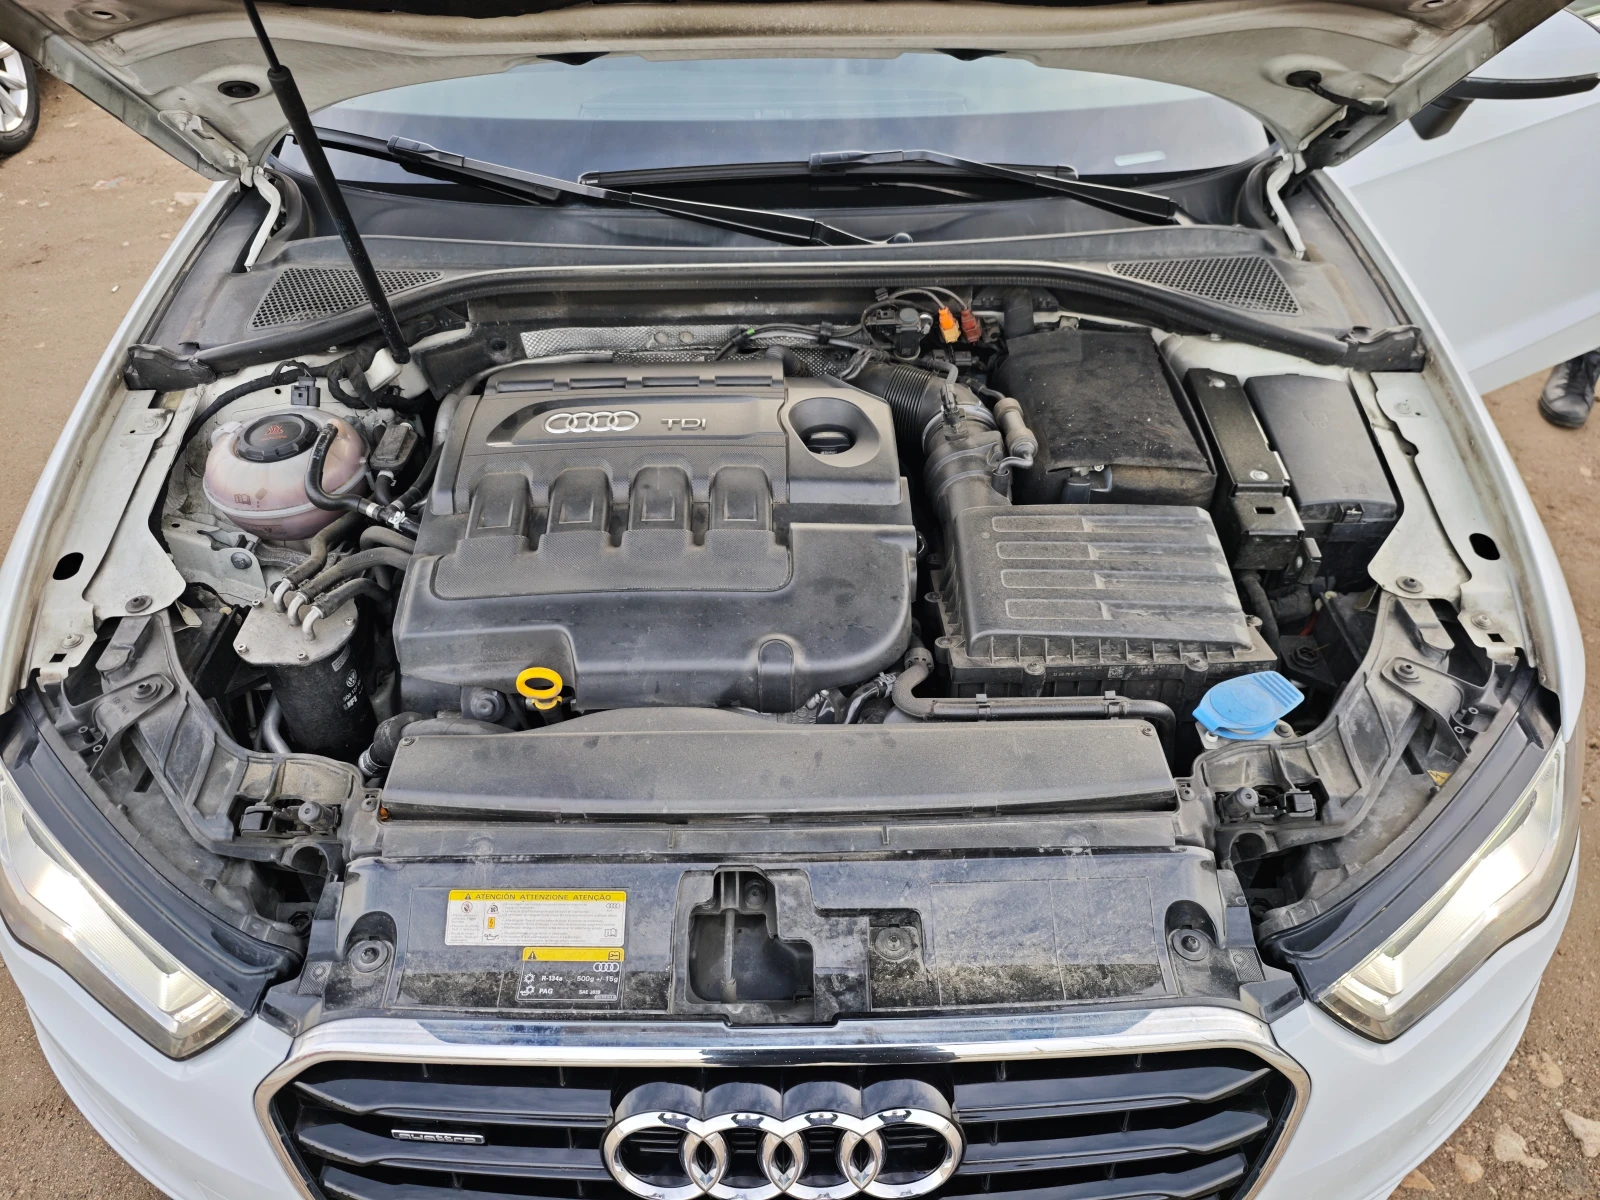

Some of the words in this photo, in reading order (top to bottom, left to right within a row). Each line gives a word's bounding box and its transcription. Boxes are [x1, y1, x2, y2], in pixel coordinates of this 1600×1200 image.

[661, 418, 707, 431] TDI
[577, 975, 595, 983] 500g
[605, 975, 619, 983] 15g
[399, 1133, 476, 1143] quattro
